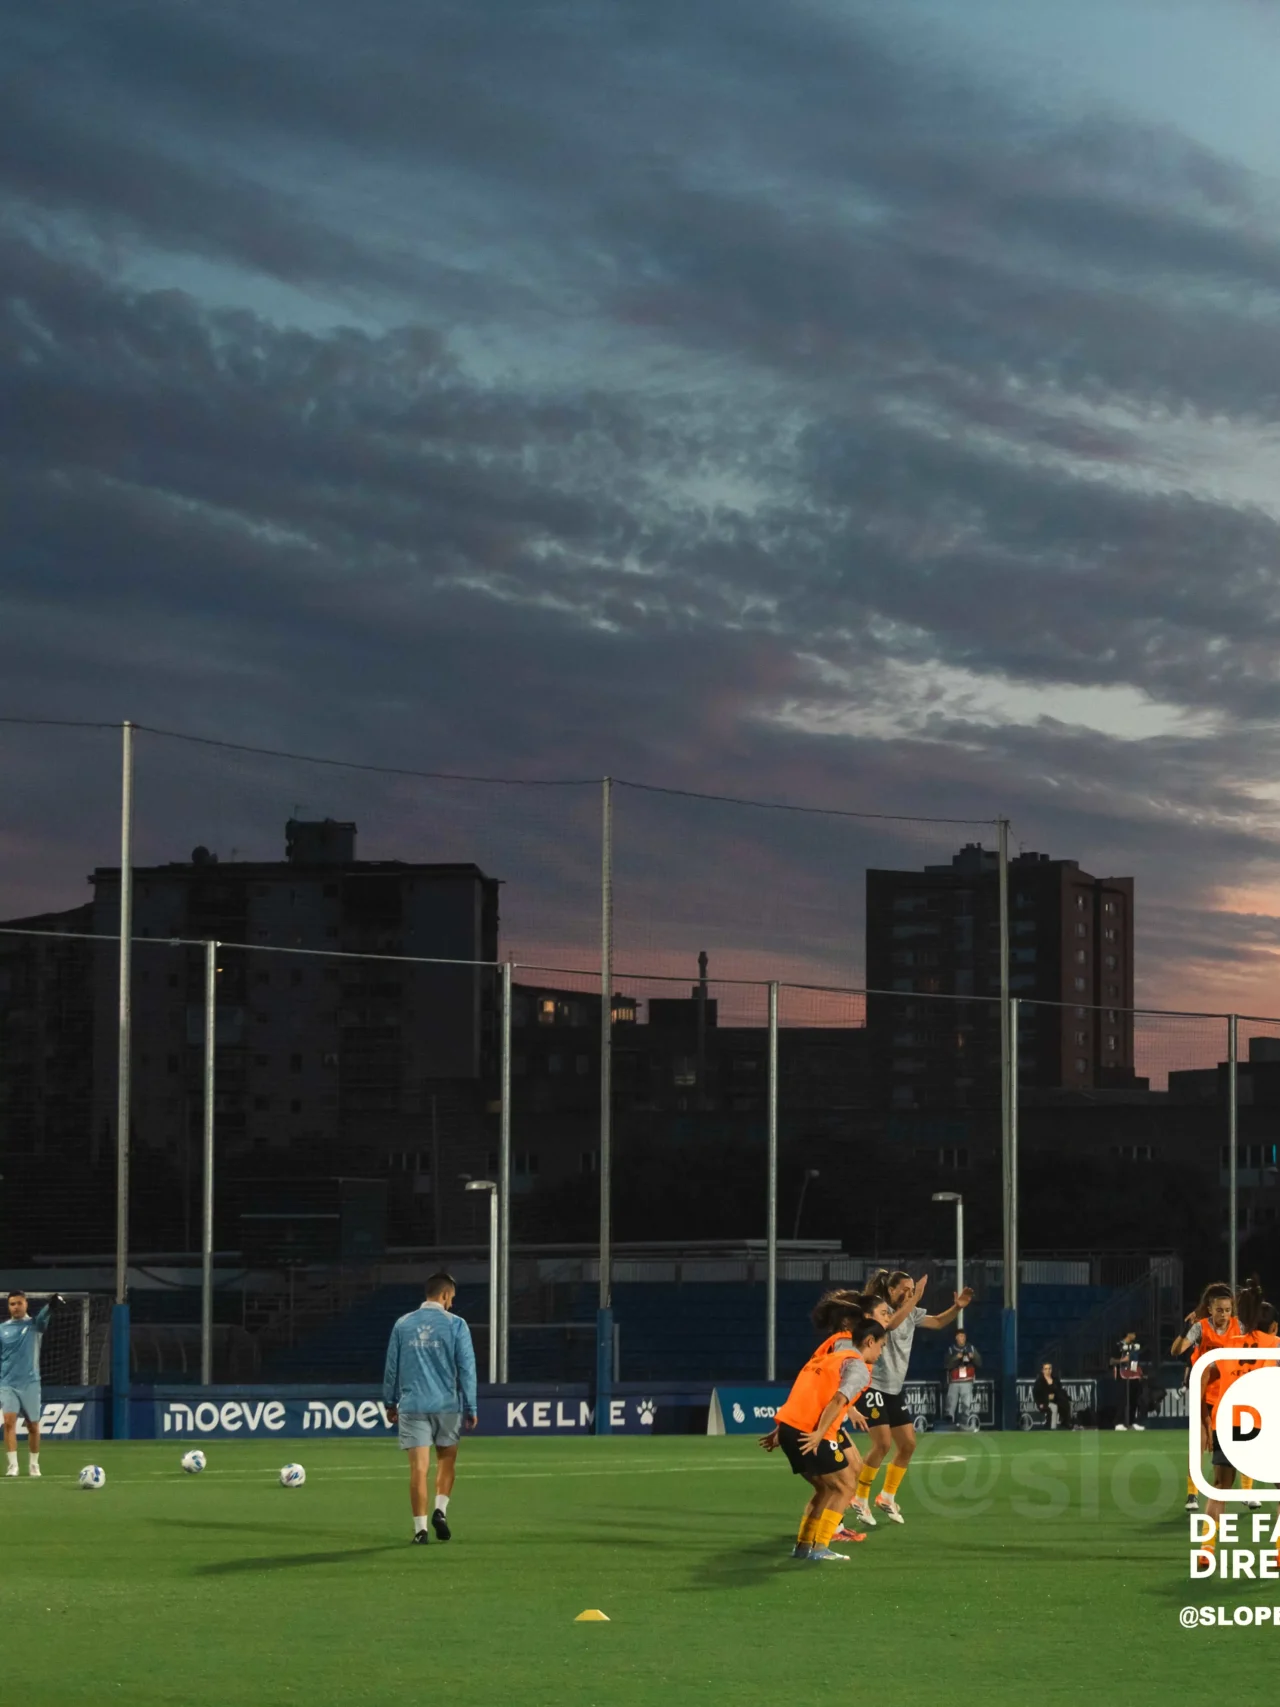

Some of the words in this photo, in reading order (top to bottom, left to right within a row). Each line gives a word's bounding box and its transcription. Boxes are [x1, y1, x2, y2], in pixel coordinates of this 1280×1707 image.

[865, 1391, 884, 1408] 20
[164, 1401, 286, 1432] moeve
[753, 1407, 775, 1419] RCD
